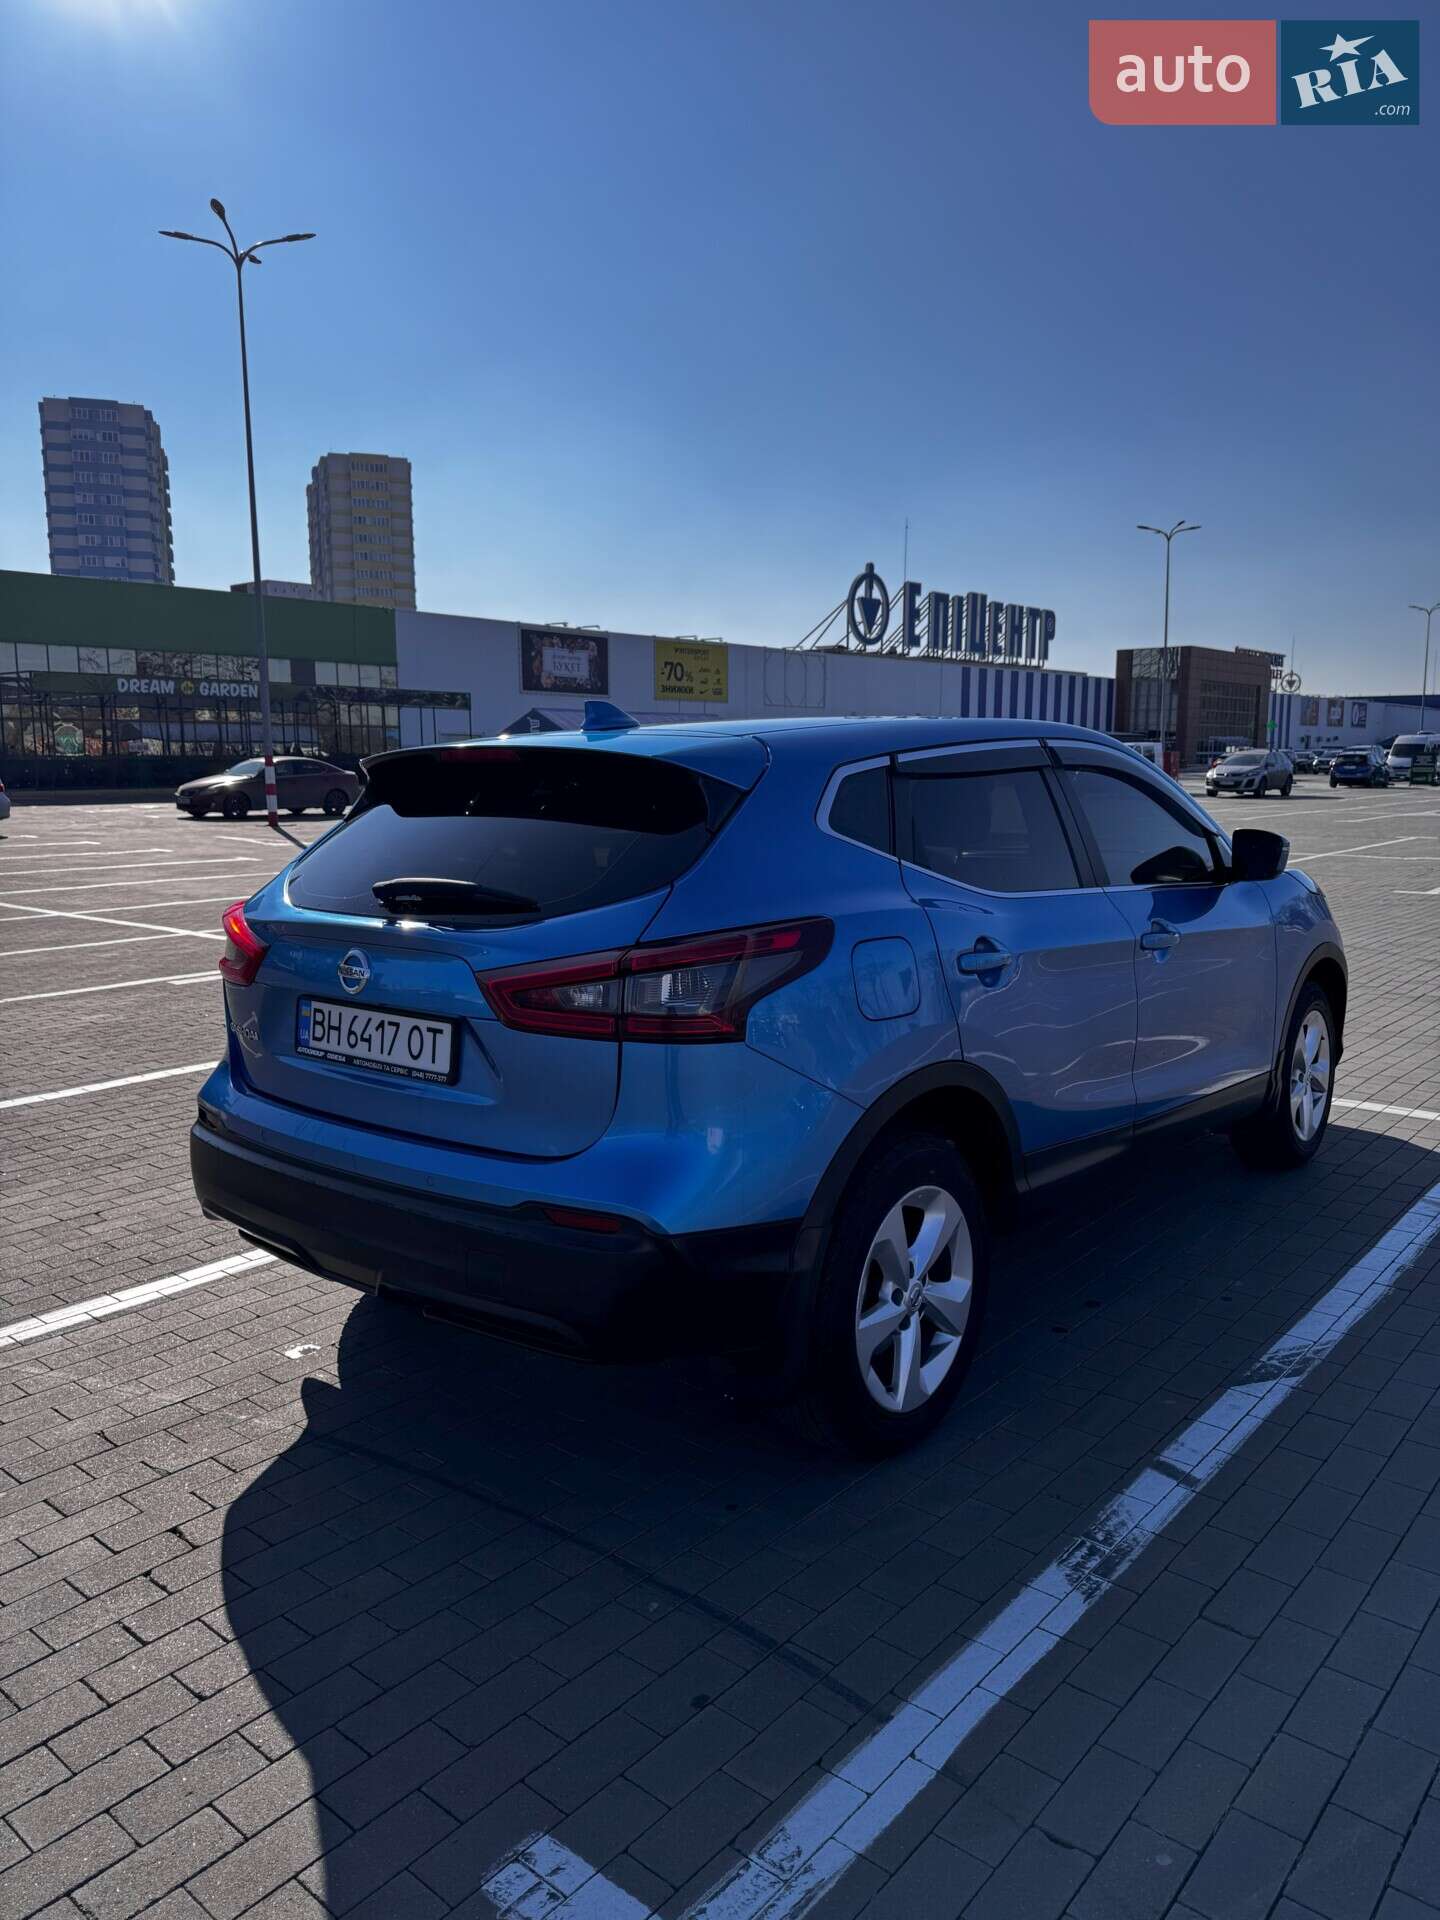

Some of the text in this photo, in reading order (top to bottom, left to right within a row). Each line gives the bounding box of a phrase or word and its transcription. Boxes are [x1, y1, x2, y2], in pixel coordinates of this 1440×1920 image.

[903, 581, 1056, 660] ЕПІЦЕНТР
[117, 678, 258, 698] DREAM GARDEN
[312, 1007, 444, 1065] BH 6417 OT
